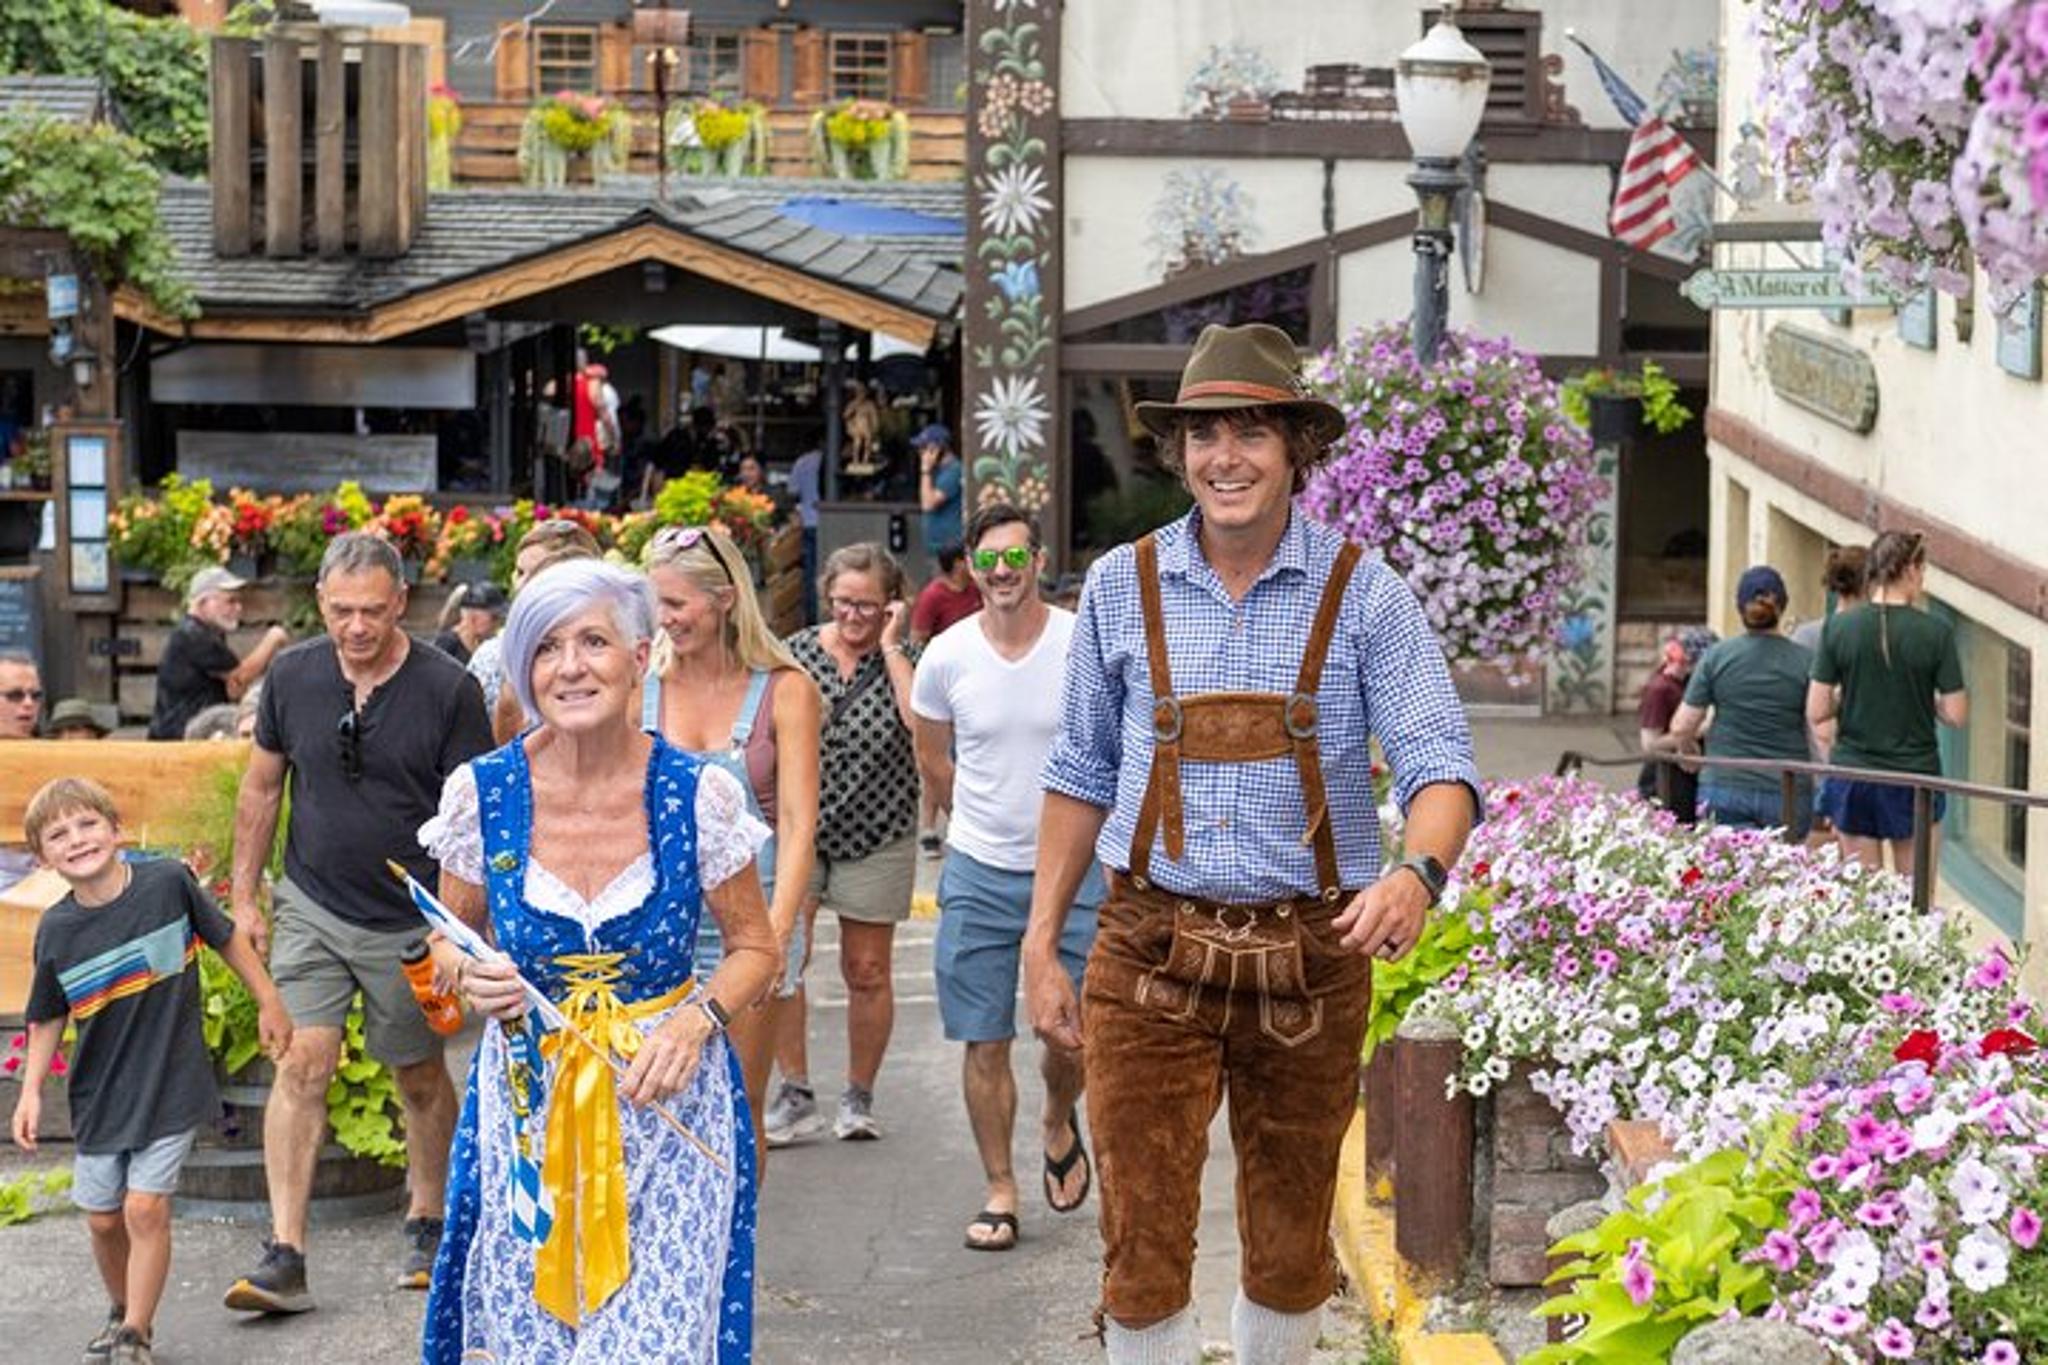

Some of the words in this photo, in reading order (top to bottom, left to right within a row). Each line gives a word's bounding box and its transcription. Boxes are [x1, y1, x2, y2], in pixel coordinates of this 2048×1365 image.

[1720, 275, 1736, 296] A
[1742, 274, 1808, 296] Matter
[1811, 274, 1829, 296] of
